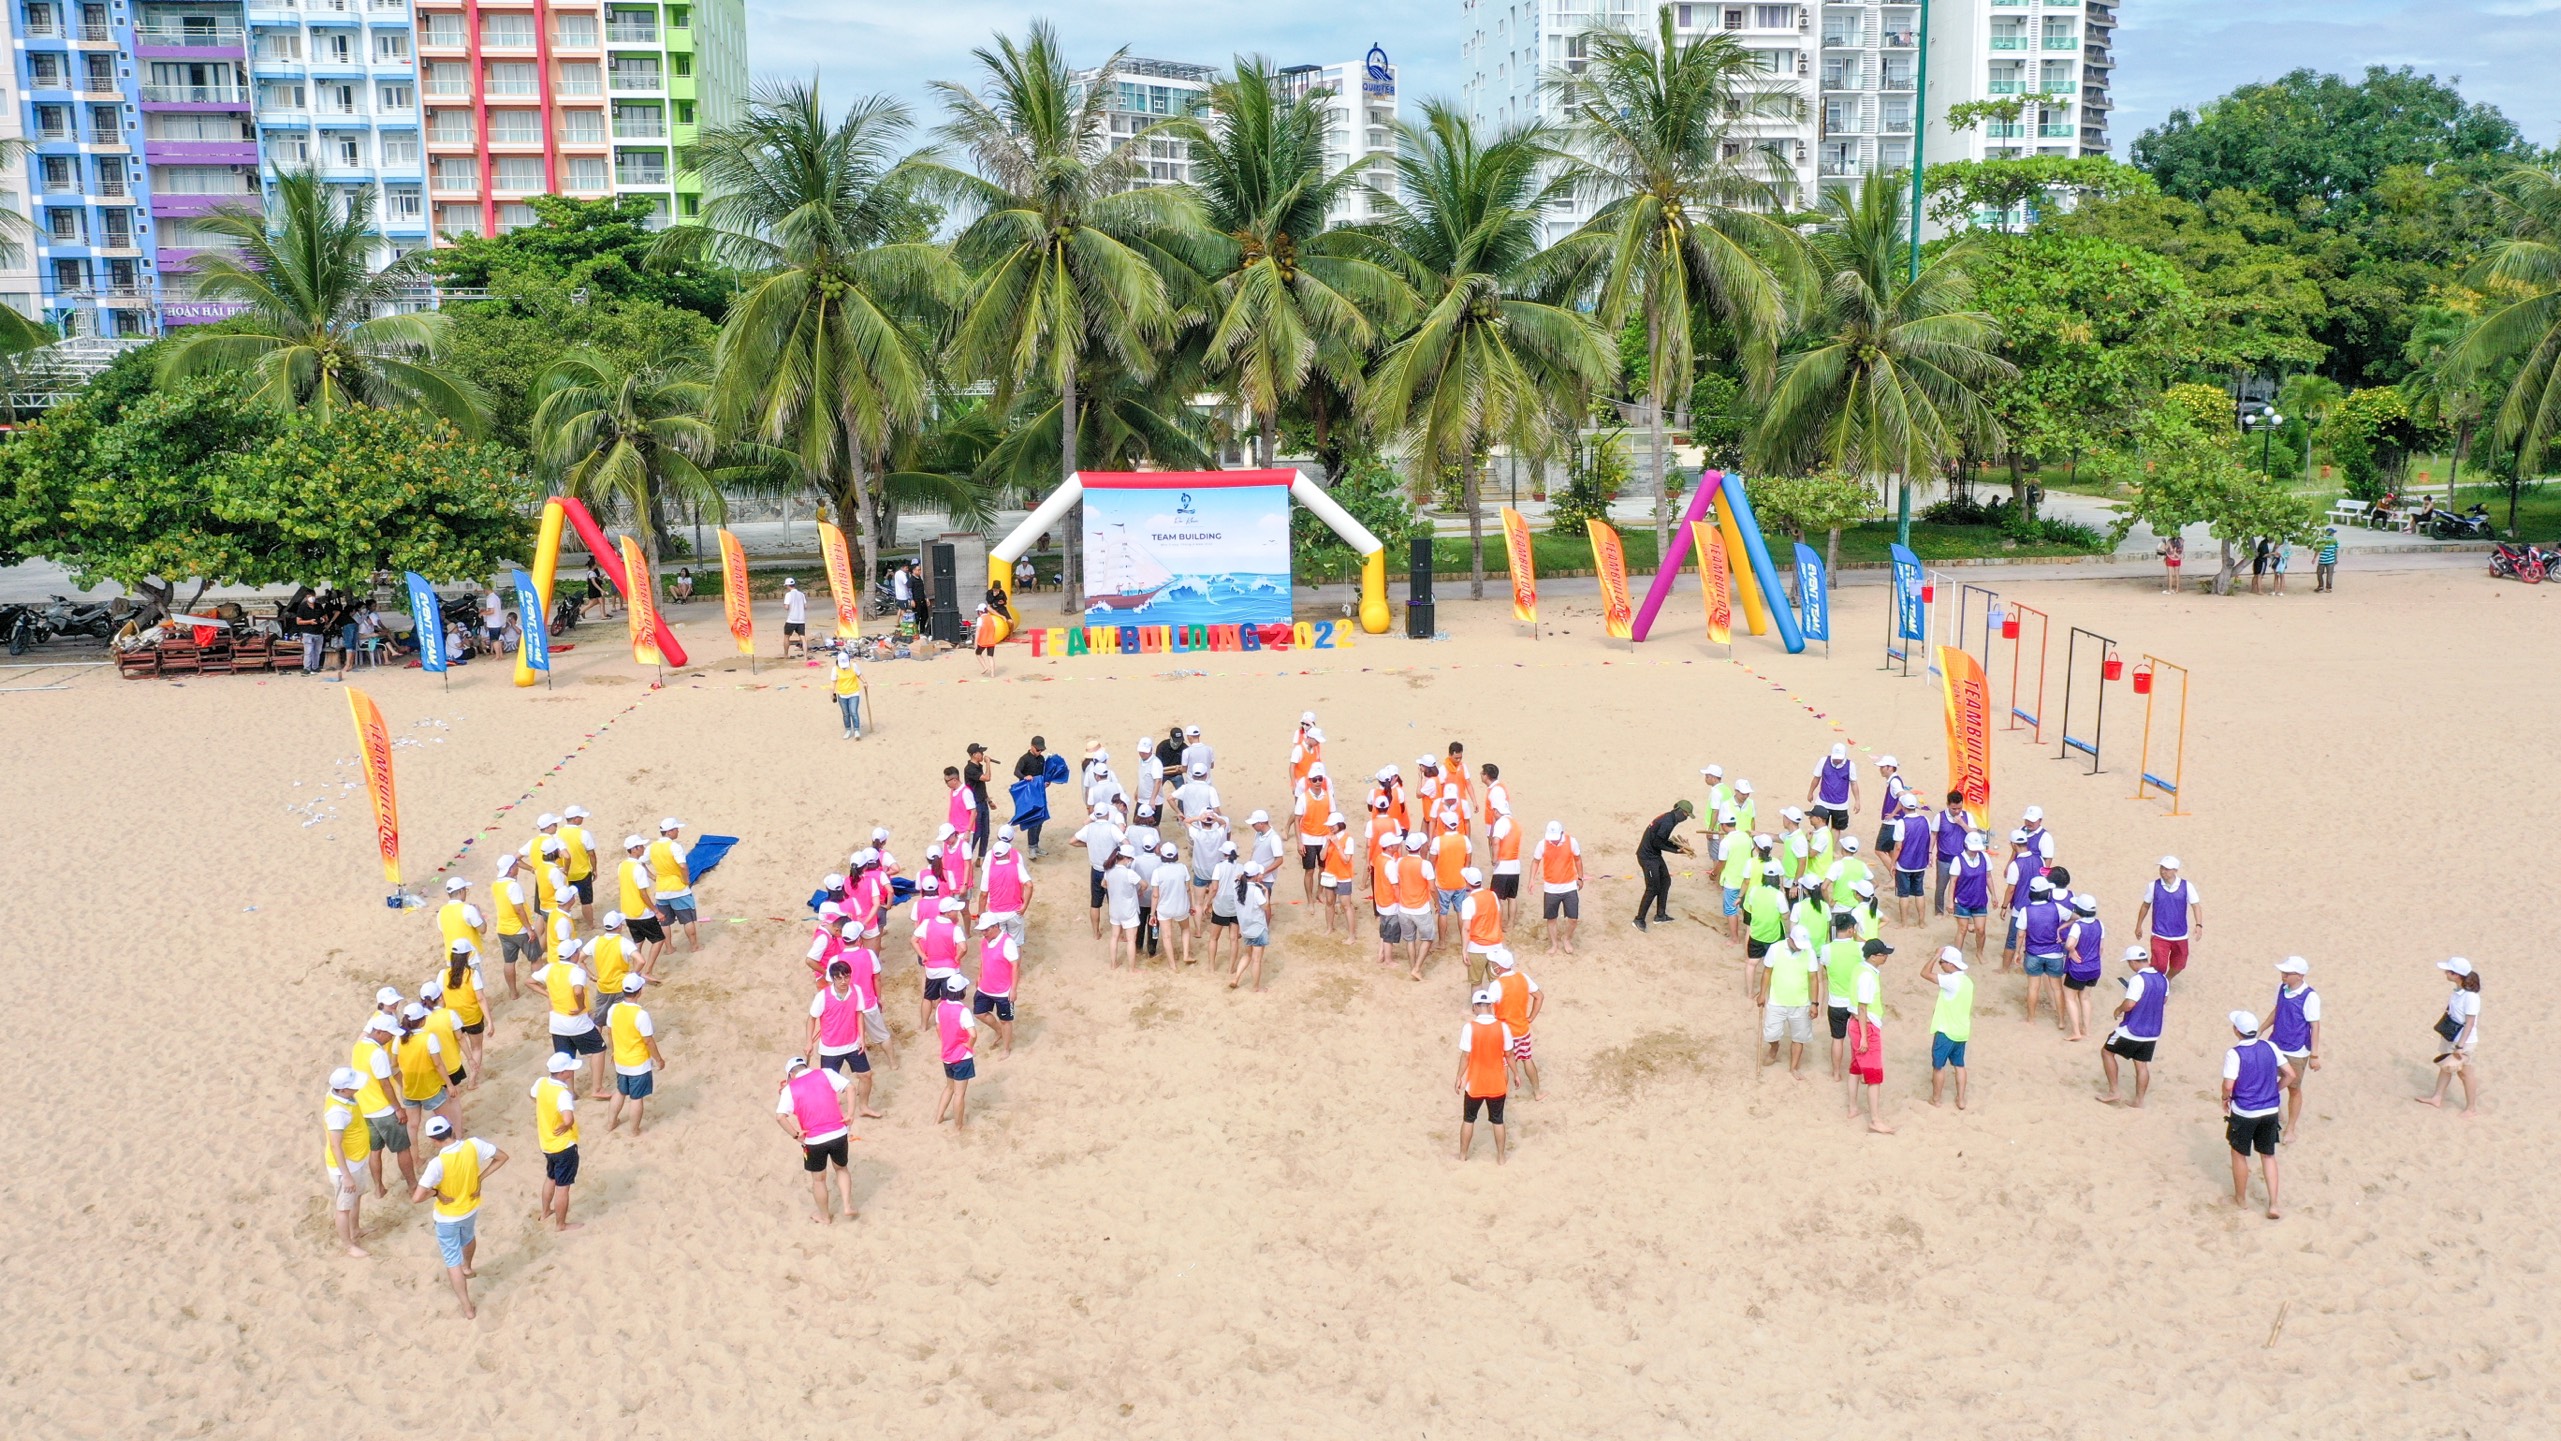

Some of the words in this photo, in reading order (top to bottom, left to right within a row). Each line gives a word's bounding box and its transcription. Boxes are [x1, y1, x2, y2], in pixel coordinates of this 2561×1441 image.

[1515, 528, 1531, 608] TEAMBUILDING
[1710, 543, 1728, 628] TEAMBUILDING
[1807, 562, 1818, 601] EVENT
[419, 592, 432, 632] EVENT
[426, 633, 438, 666] TEAM
[524, 590, 537, 631] EVENT
[1028, 622, 1261, 657] TEAMBUILDING
[1270, 619, 1355, 652] 2022
[1810, 603, 1821, 634] TEAM
[1964, 679, 1984, 805] TEAMBUILDING
[369, 723, 395, 858] TEAMBUILDING
